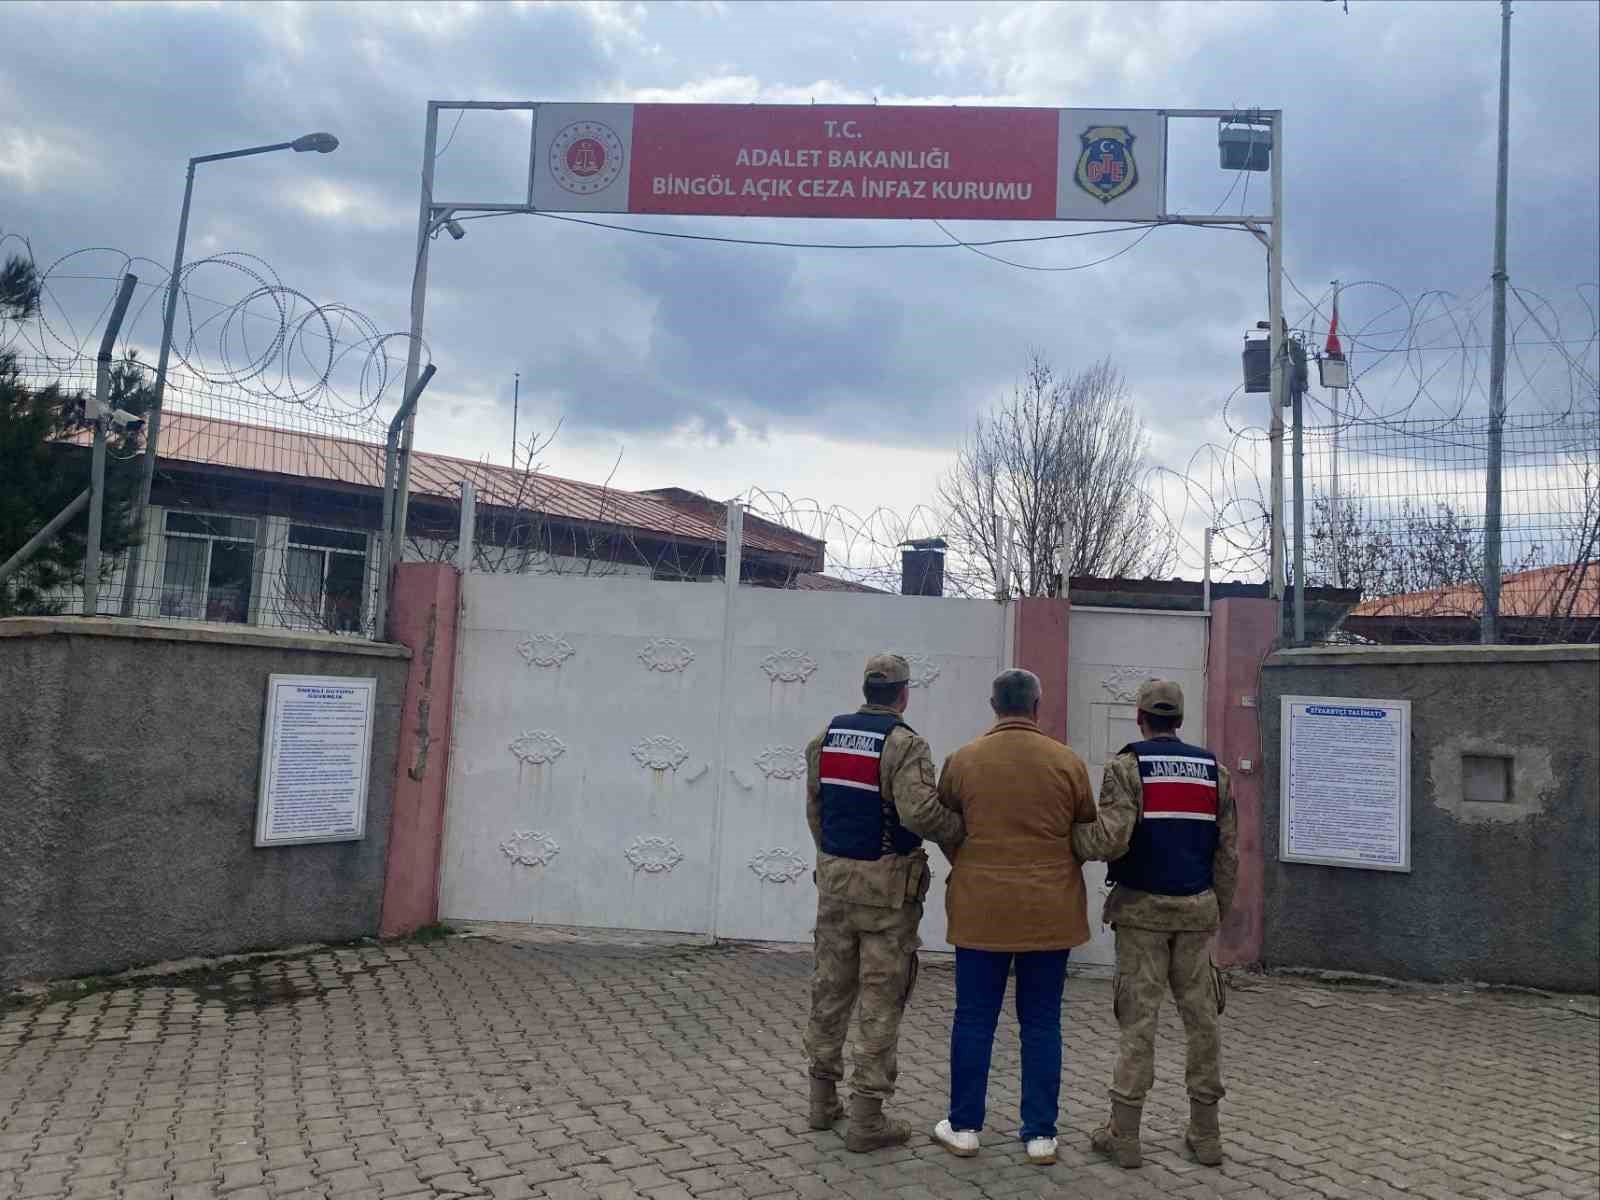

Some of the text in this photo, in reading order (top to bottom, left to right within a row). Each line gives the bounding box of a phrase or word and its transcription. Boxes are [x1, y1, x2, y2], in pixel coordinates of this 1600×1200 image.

[824, 120, 862, 138] T.C.
[736, 147, 950, 169] ADALET BAKANLIĞI
[653, 173, 1033, 201] BİNGÖL AÇIK CEZA İNFAZ KURUMU
[828, 733, 876, 752] JANDARMA
[1150, 761, 1209, 779] JANDARMA
